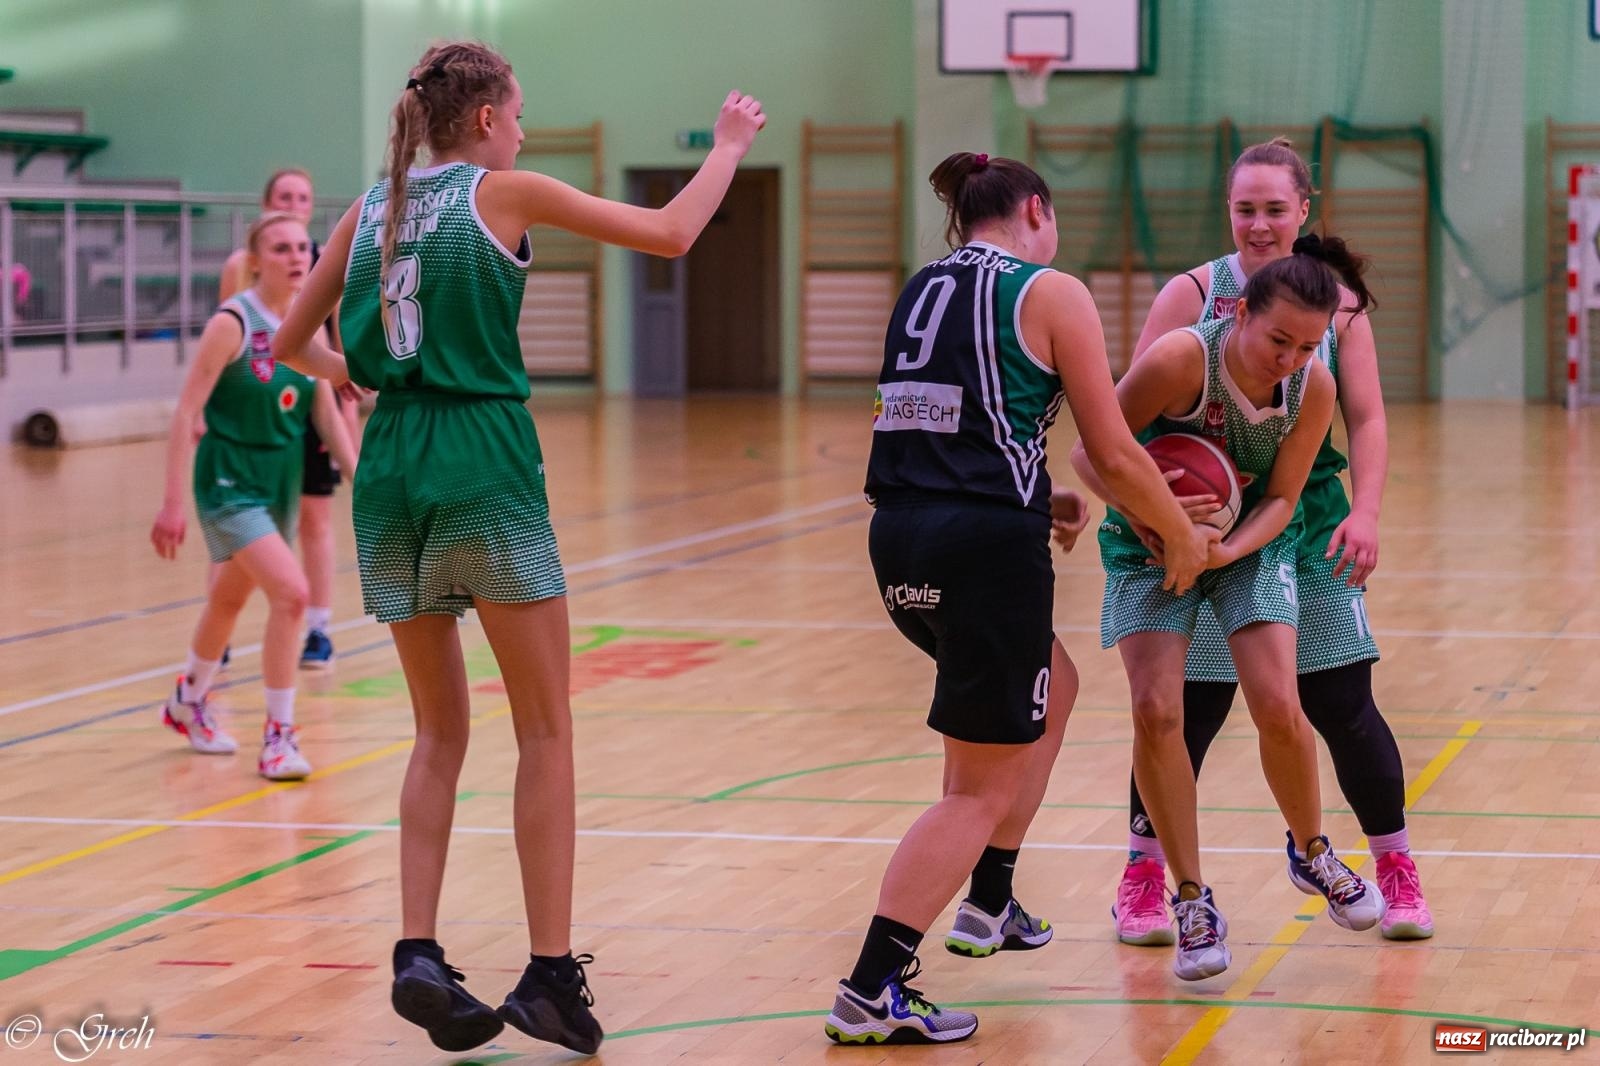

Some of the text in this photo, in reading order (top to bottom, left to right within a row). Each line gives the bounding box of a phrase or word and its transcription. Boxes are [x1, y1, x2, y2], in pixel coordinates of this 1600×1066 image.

[381, 252, 423, 360] 8
[896, 275, 957, 371] 9
[894, 583, 941, 605] Clavis
[1032, 667, 1050, 721] 9
